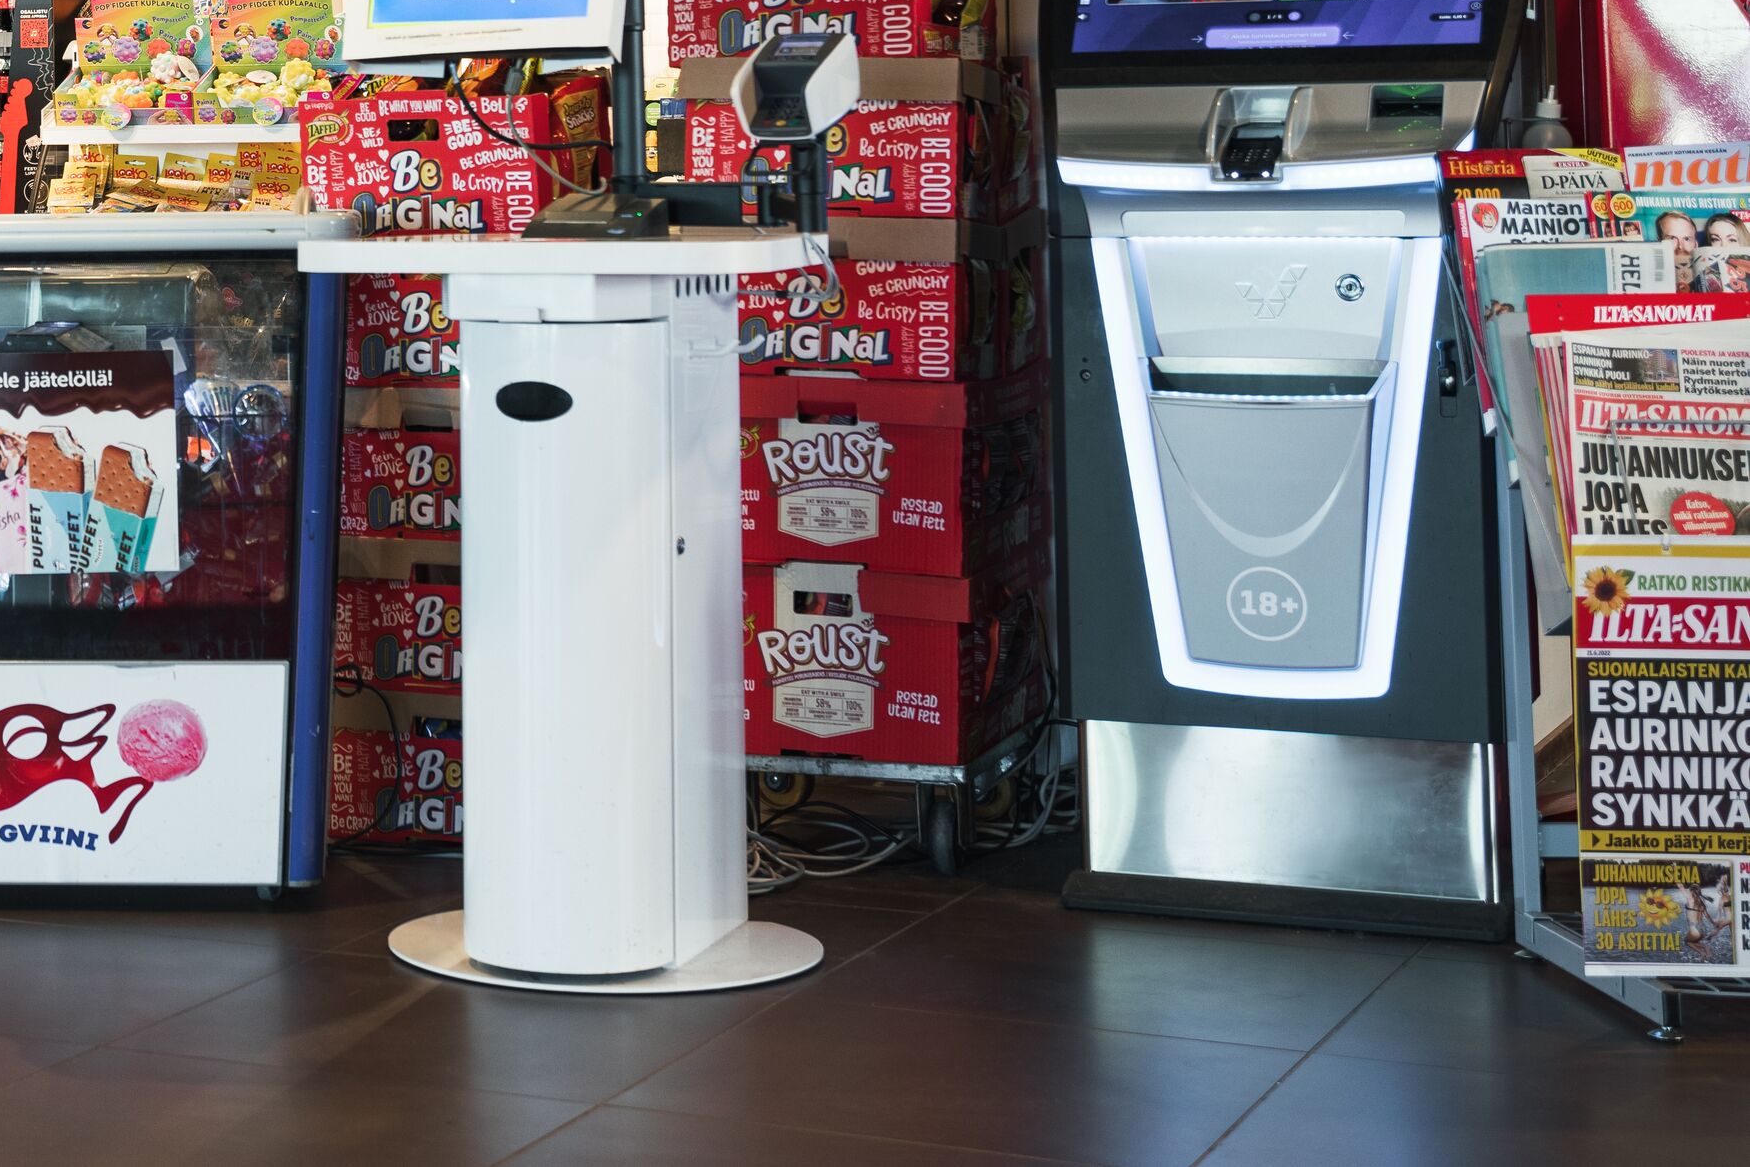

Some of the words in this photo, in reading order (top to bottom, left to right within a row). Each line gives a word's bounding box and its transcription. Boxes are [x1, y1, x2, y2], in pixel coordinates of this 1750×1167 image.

[94, 2, 111, 12] POP
[111, 0, 139, 9] FIDGET
[139, 0, 191, 11] KUPLAPALLO
[231, 2, 248, 12] POP
[249, 0, 276, 9] FIDGET
[277, 0, 329, 11] KUPLAPALLO
[359, 102, 370, 112] BE
[378, 99, 390, 117] BE
[389, 99, 409, 113] WHAT
[409, 100, 423, 112] YOU
[423, 99, 443, 112] WANT
[355, 111, 377, 123] GOOD
[886, 111, 951, 132] CRUNCHY
[307, 121, 340, 138] TAFFEL
[360, 137, 385, 149] WILD
[447, 131, 483, 150] GOOD
[877, 138, 919, 160] Crispy
[474, 146, 531, 168] CRUNCHY
[1556, 160, 1586, 168] EKSTRA
[1586, 148, 1619, 164] UUTUUS
[389, 149, 444, 193] Be
[1448, 159, 1515, 178] Historia
[452, 174, 467, 191] Be
[467, 172, 505, 193] Crispy
[1540, 171, 1608, 191] D-PÄIVÄ
[1506, 200, 1582, 216] Mantan
[1612, 200, 1633, 212] 600
[1635, 196, 1671, 209] MUKANA
[1672, 195, 1697, 209] MYÖS
[1699, 196, 1738, 209] RISTIKOT
[1572, 343, 1611, 358] ESPANJAN
[1611, 348, 1653, 359] AURINKO-
[1680, 348, 1717, 357] PUOLESTA
[1573, 356, 1612, 369] RANNIKON
[1681, 357, 1708, 368] Näin
[1709, 358, 1745, 368] nuoret
[1682, 366, 1716, 376] naiset
[22, 369, 113, 393] jäätelöllä!
[1573, 366, 1605, 380] SYNKKÄ
[1605, 371, 1630, 381] PUOLI
[1683, 375, 1738, 388] Rydmanin
[1581, 479, 1649, 514] JOPA
[29, 503, 45, 570] PUFFET
[1637, 574, 1687, 591] RATKO
[1240, 590, 1299, 617] 18+
[1587, 661, 1720, 679] SUOMALAISTEN
[815, 698, 832, 709] 58%
[1605, 833, 1660, 848] Jaakko
[1664, 834, 1714, 852] päätyi
[1592, 863, 1700, 884] JUHANNUKSENA
[1594, 886, 1628, 905] JOPA
[1594, 908, 1638, 928] LÄHES
[1596, 932, 1614, 951] 30
[1618, 932, 1681, 952] ASTETTA!
